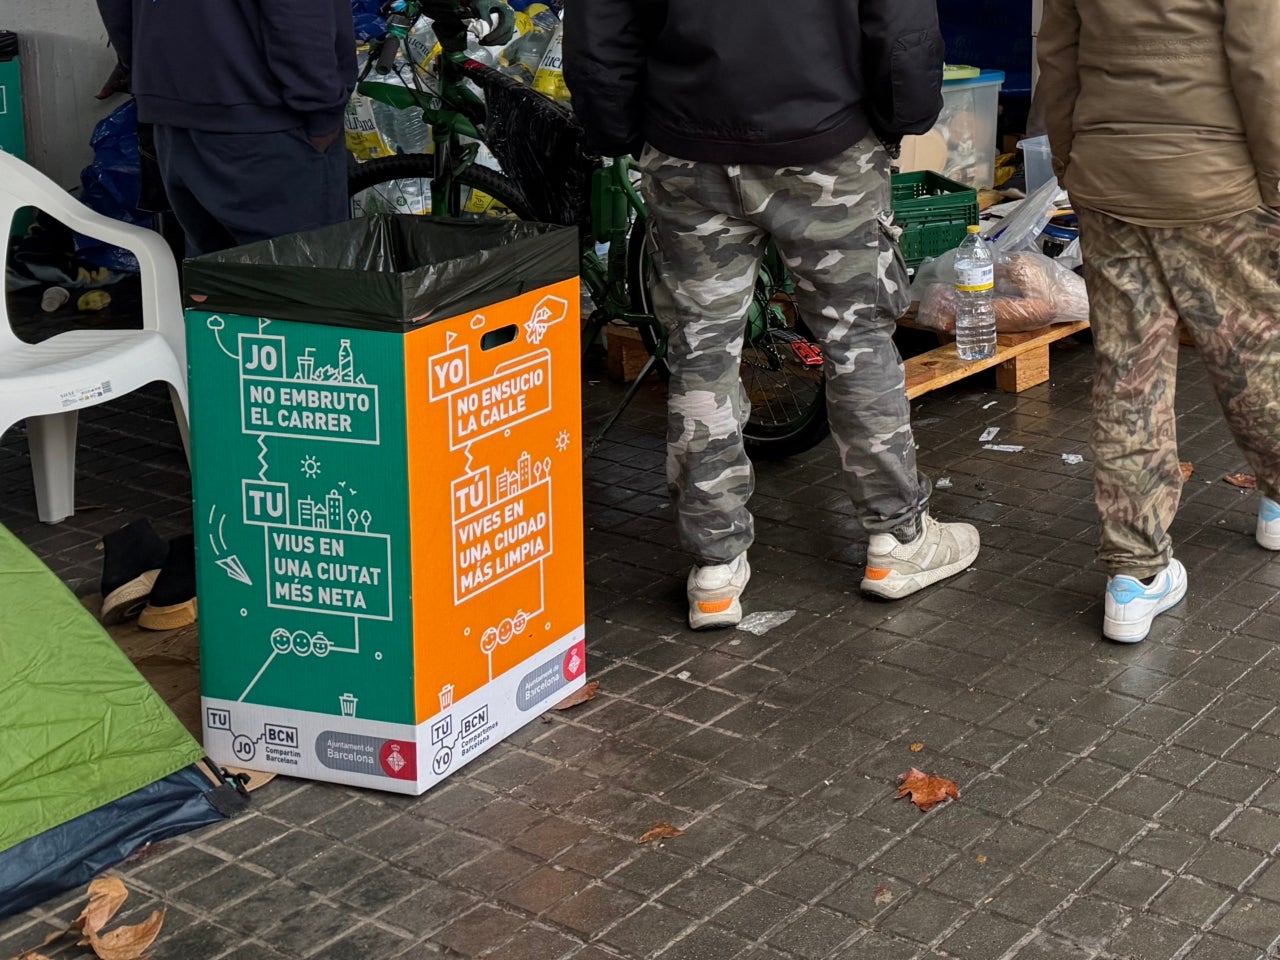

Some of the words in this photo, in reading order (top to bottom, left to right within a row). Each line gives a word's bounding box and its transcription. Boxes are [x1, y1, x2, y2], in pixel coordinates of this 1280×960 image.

[245, 345, 277, 371] JO
[434, 359, 463, 389] YO
[250, 386, 275, 406] NO
[280, 388, 370, 412] EMBRUTO
[457, 393, 479, 417] NO
[482, 368, 543, 406] ENSUCIO
[251, 407, 274, 426] EL
[277, 409, 352, 432] CARRER
[458, 414, 478, 437] LA
[480, 394, 526, 428] CALLE
[249, 490, 283, 518] TU
[456, 474, 484, 514] TÚ
[459, 510, 502, 545] VIVES
[504, 499, 524, 523] EN
[273, 533, 315, 554] VIUS
[319, 537, 344, 557] EN
[460, 539, 492, 569] UNA
[494, 511, 546, 551] CIUDAD
[274, 557, 313, 579] UNA
[317, 562, 381, 586] CIUTAT
[461, 561, 492, 593] MÁS
[496, 536, 544, 575] LIMPIA
[275, 579, 313, 603] MÉS
[318, 587, 367, 609] NETA
[525, 673, 560, 701] Barcelona
[210, 713, 227, 726] TU
[434, 719, 450, 740] TÚ
[464, 710, 485, 734] BCN
[236, 741, 251, 755] JO
[268, 729, 294, 744] BCN
[327, 739, 364, 753] Ajuntament
[366, 745, 374, 753] de
[461, 720, 499, 750] Compartimos
[461, 734, 490, 757] Barcelona
[265, 746, 301, 758] Compartim
[265, 754, 298, 766] Barcelona
[327, 748, 374, 765] Barcelona
[435, 751, 450, 770] YO
